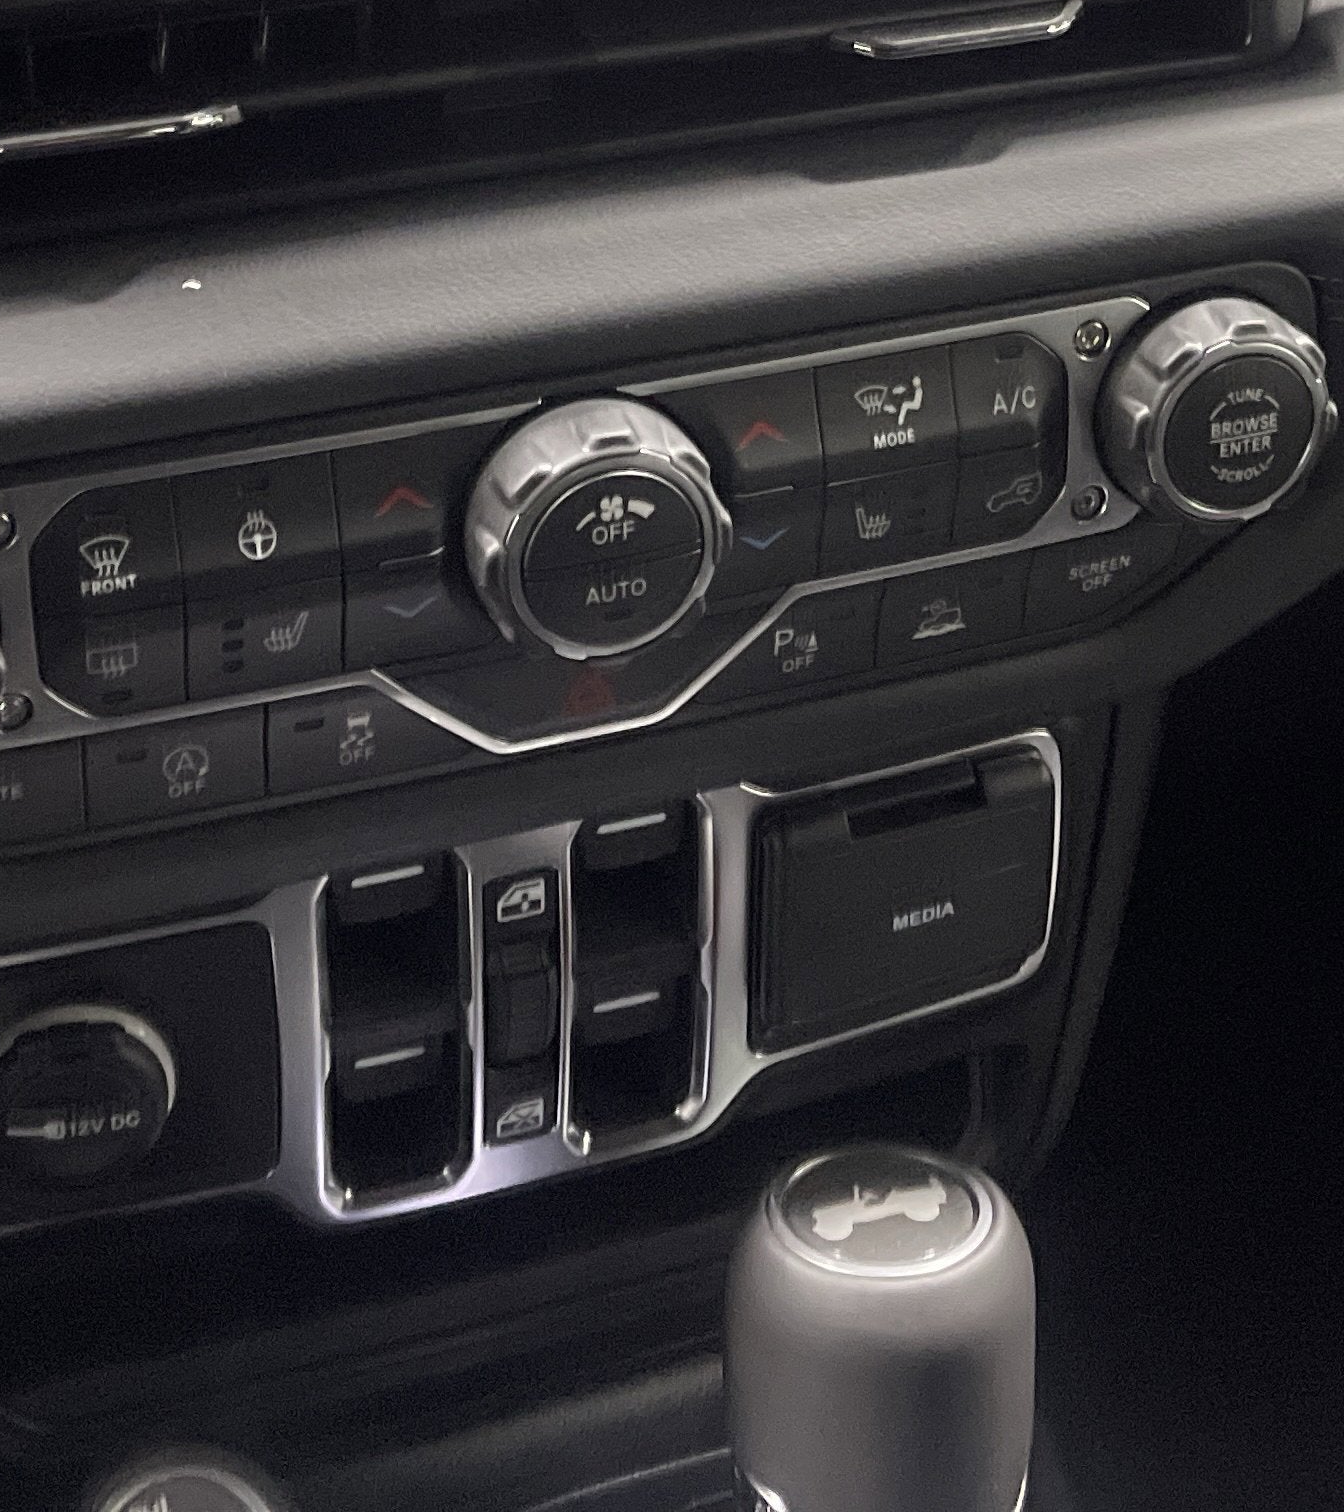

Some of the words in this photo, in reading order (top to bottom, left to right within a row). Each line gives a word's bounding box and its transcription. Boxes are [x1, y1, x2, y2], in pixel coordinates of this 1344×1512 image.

[993, 385, 1037, 416] A/C
[1227, 388, 1265, 405] TUNE
[1211, 412, 1278, 439] BROWSE
[873, 427, 915, 450] MODE
[1219, 435, 1271, 458] ENTER
[1217, 463, 1269, 482] SCROLL
[592, 519, 636, 545] OFF
[1068, 555, 1131, 580] SCREEN
[80, 573, 136, 599] FRONT
[585, 577, 647, 605] AUTO
[1082, 573, 1113, 592] OFF
[782, 654, 815, 673] OFF
[339, 746, 375, 766] OFF
[167, 778, 205, 799] OFF
[892, 901, 954, 932] MEDIA
[70, 1116, 105, 1138] 12V
[110, 1108, 141, 1131] DC
